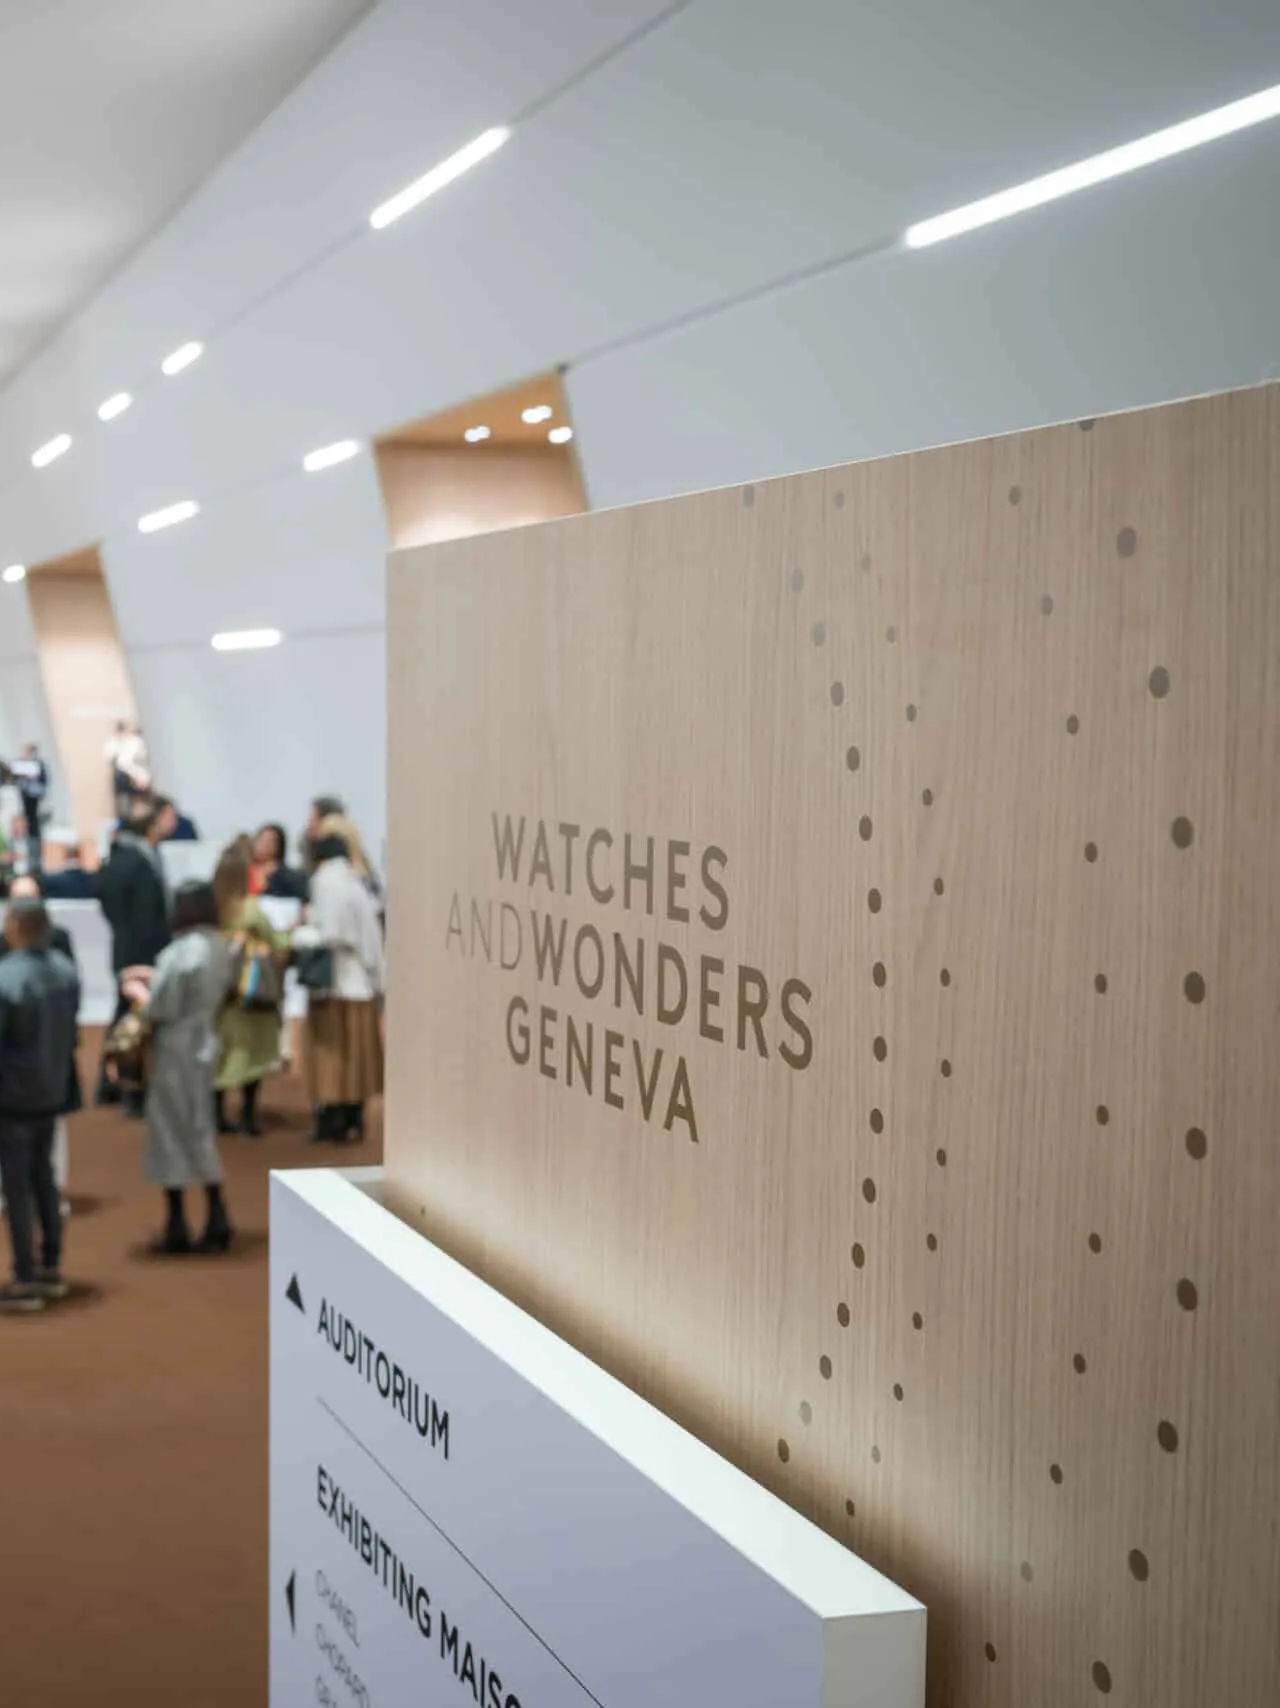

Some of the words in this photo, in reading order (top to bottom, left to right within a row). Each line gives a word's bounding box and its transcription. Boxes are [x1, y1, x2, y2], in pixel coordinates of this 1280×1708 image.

[492, 810, 730, 931] WATCHES
[506, 995, 700, 1144] GENEVA
[318, 1298, 450, 1461] AUDITORIUM
[315, 1569, 360, 1649] CHANEL
[317, 1464, 432, 1639] EXHIBITING
[440, 1610, 523, 1708] MAIS
